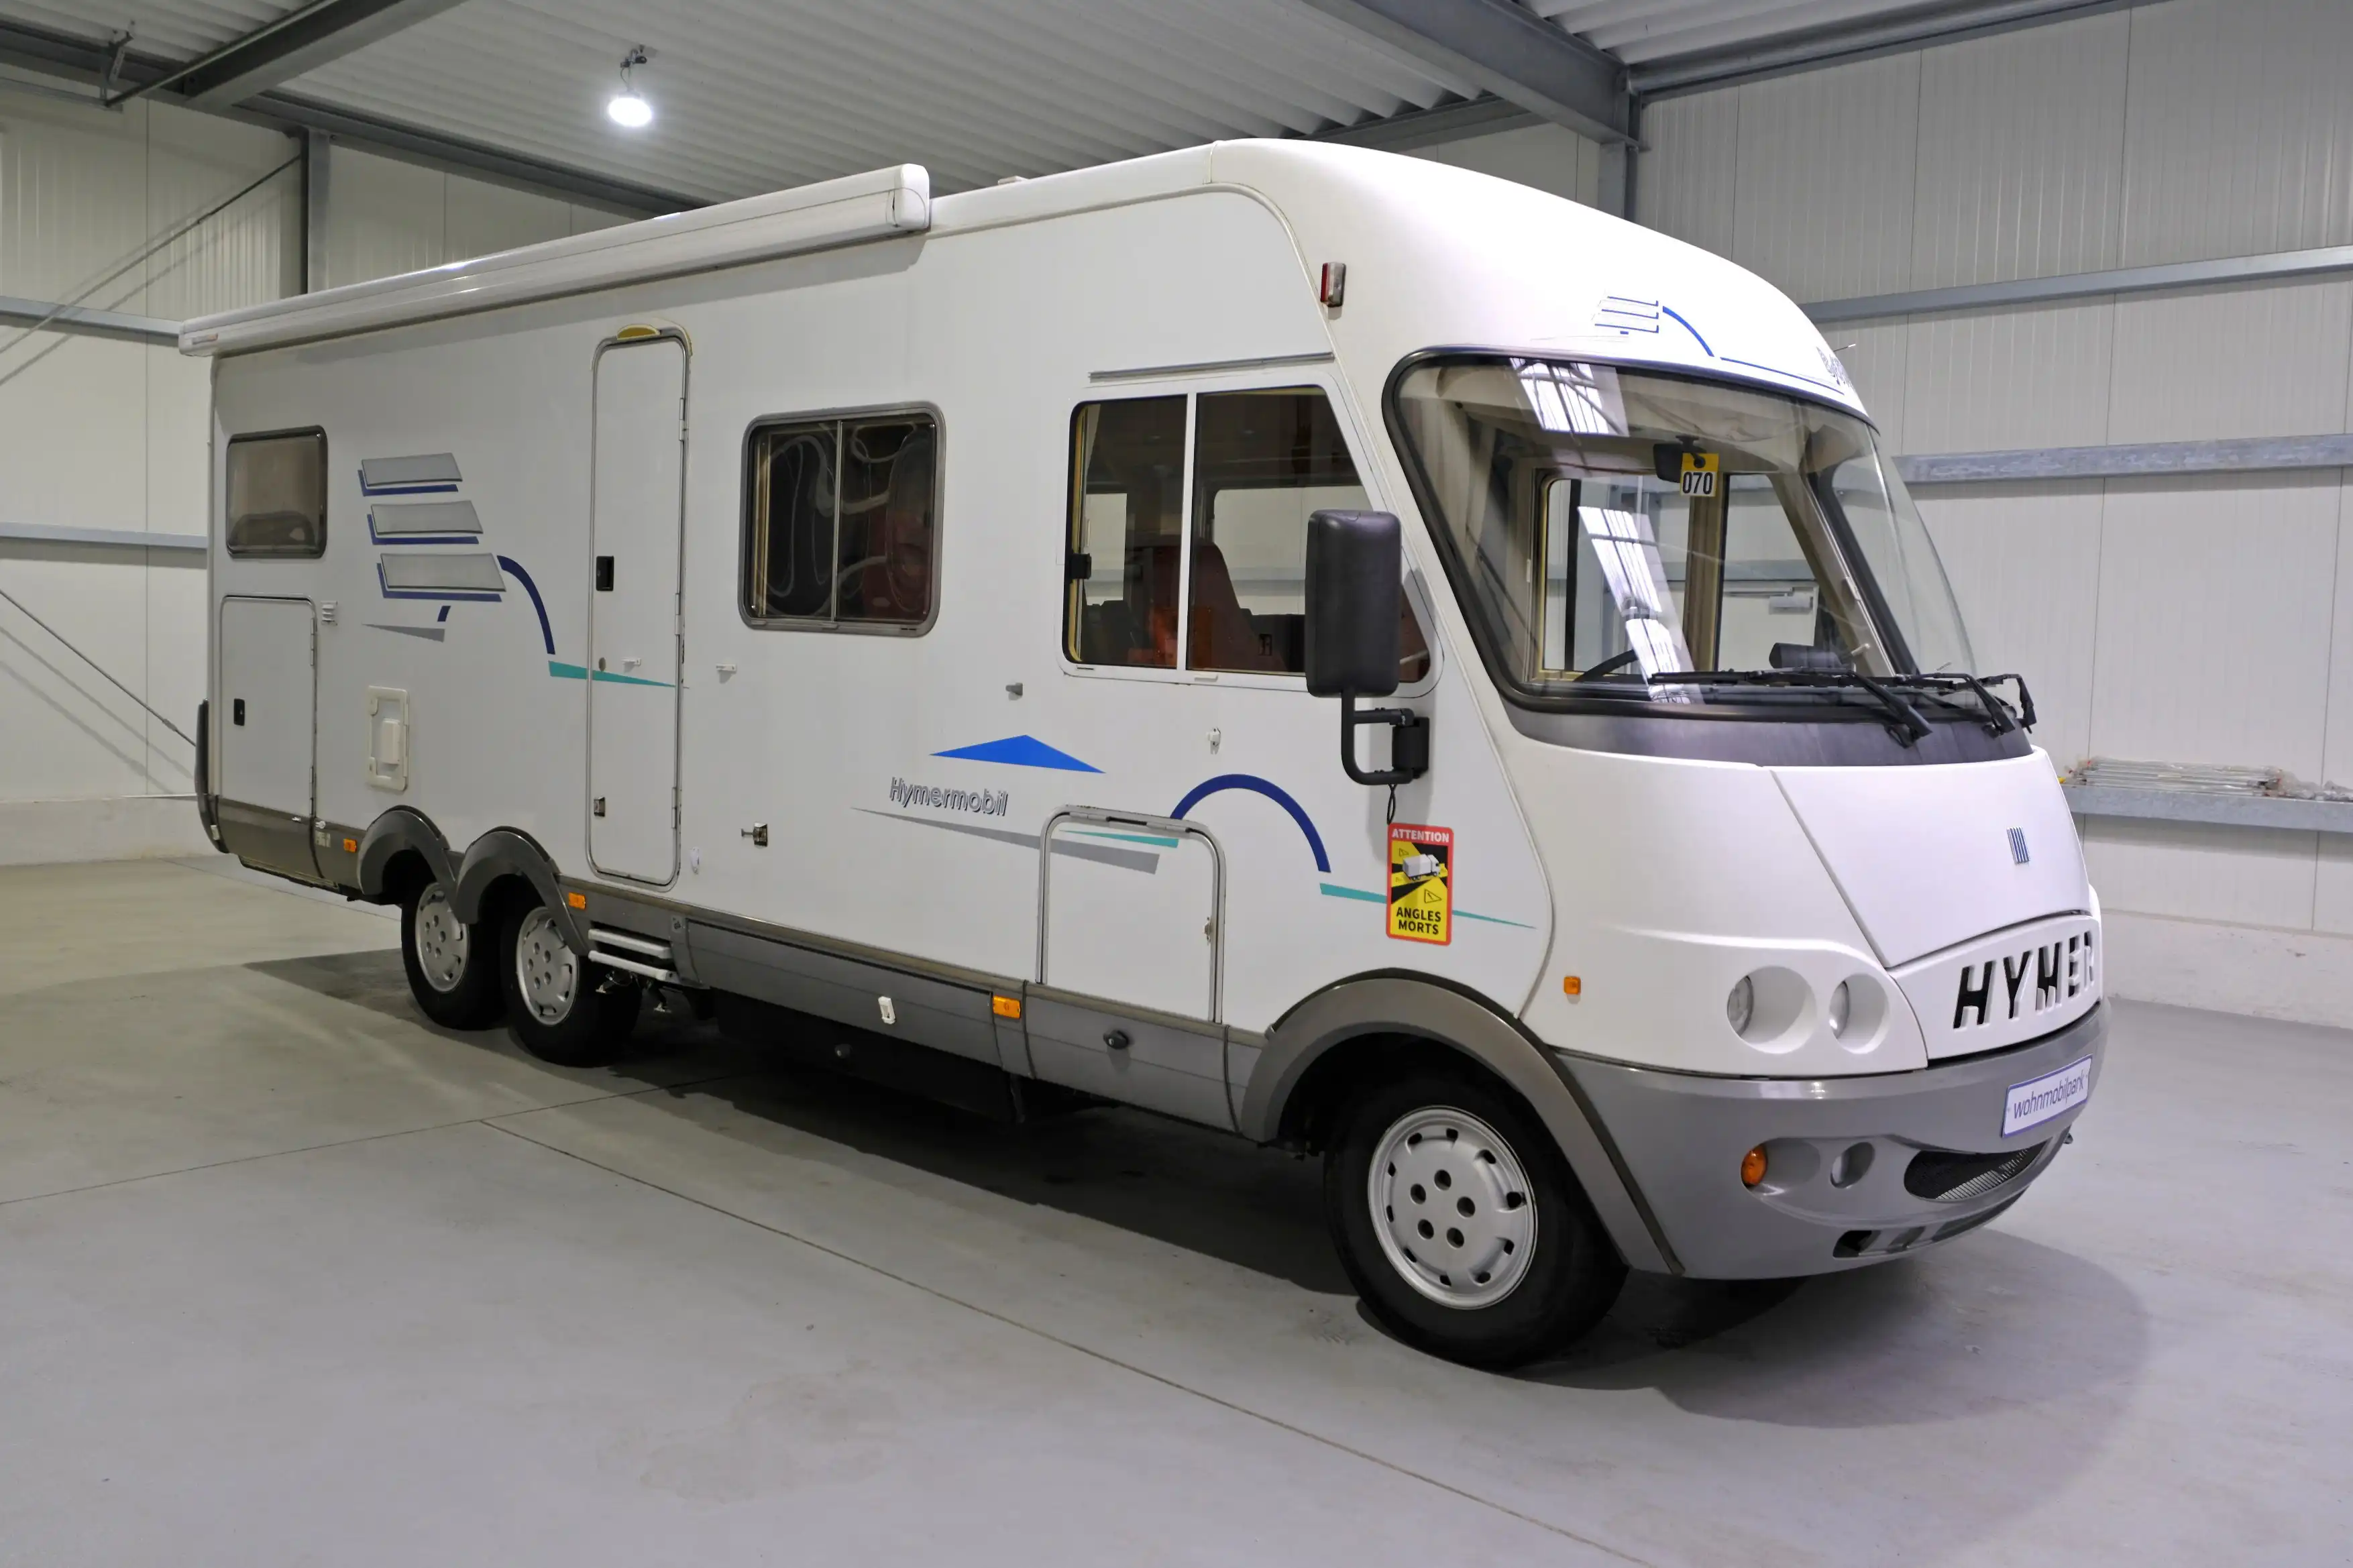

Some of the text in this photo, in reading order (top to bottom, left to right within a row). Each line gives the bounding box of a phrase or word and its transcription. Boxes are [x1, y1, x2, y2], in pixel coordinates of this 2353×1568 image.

[1682, 471, 1713, 494] 070
[889, 777, 1009, 816] Hymermobil
[1392, 828, 1449, 843] ATTENTION
[1396, 906, 1441, 923] ANGLES
[1398, 919, 1439, 935] MORTS
[1953, 930, 2095, 1029] HYMER
[2014, 1070, 2085, 1119] wohnmobilpark
